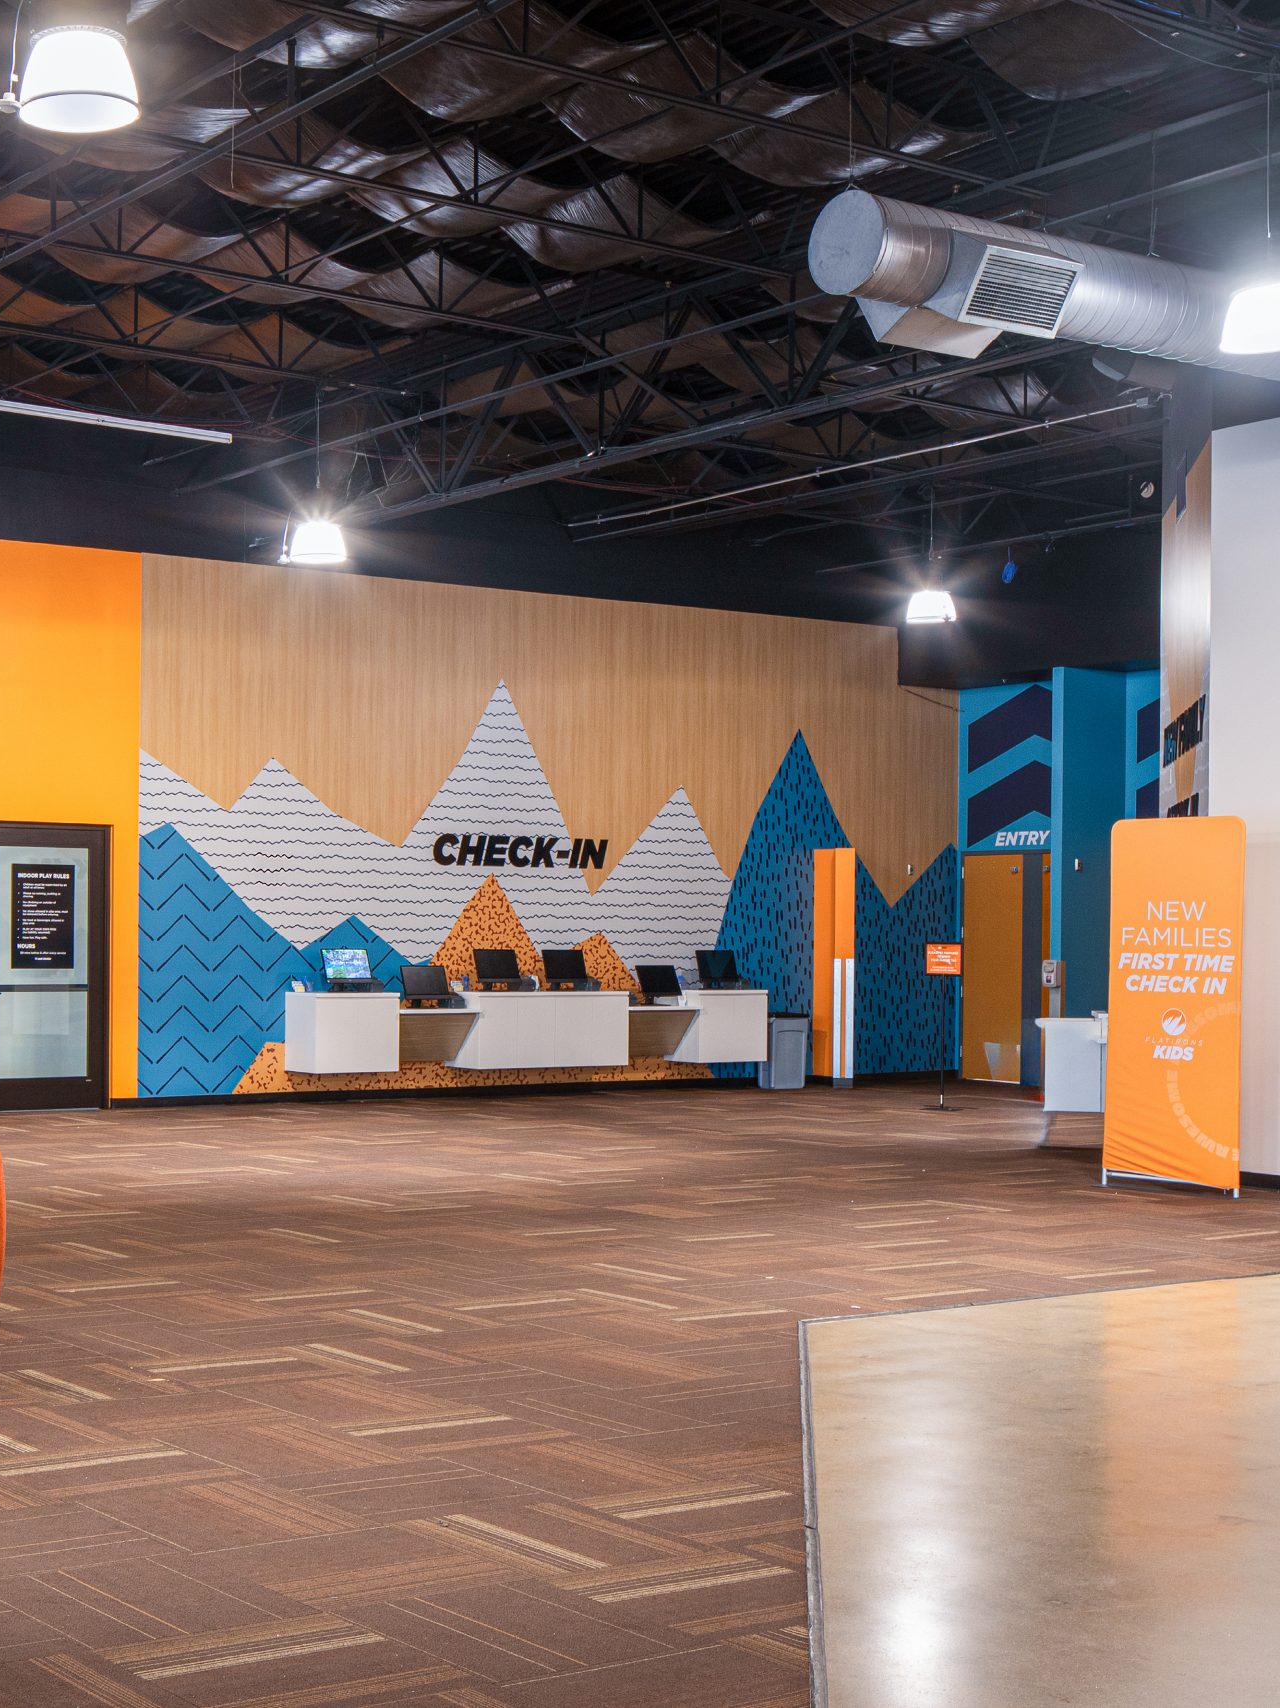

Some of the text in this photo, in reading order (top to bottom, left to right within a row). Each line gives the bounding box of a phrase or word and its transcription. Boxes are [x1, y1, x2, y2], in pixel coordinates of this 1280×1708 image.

[994, 830, 1051, 847] ENTRY
[433, 833, 609, 870] CHECK-IN
[1147, 900, 1206, 921] NEW
[1121, 927, 1232, 948] FAMILIES
[1118, 952, 1235, 973] FIRST TIME
[1125, 974, 1228, 995] CHECK IN
[1144, 1036, 1204, 1047] FLATIRONS
[1152, 1045, 1195, 1061] KIDS
